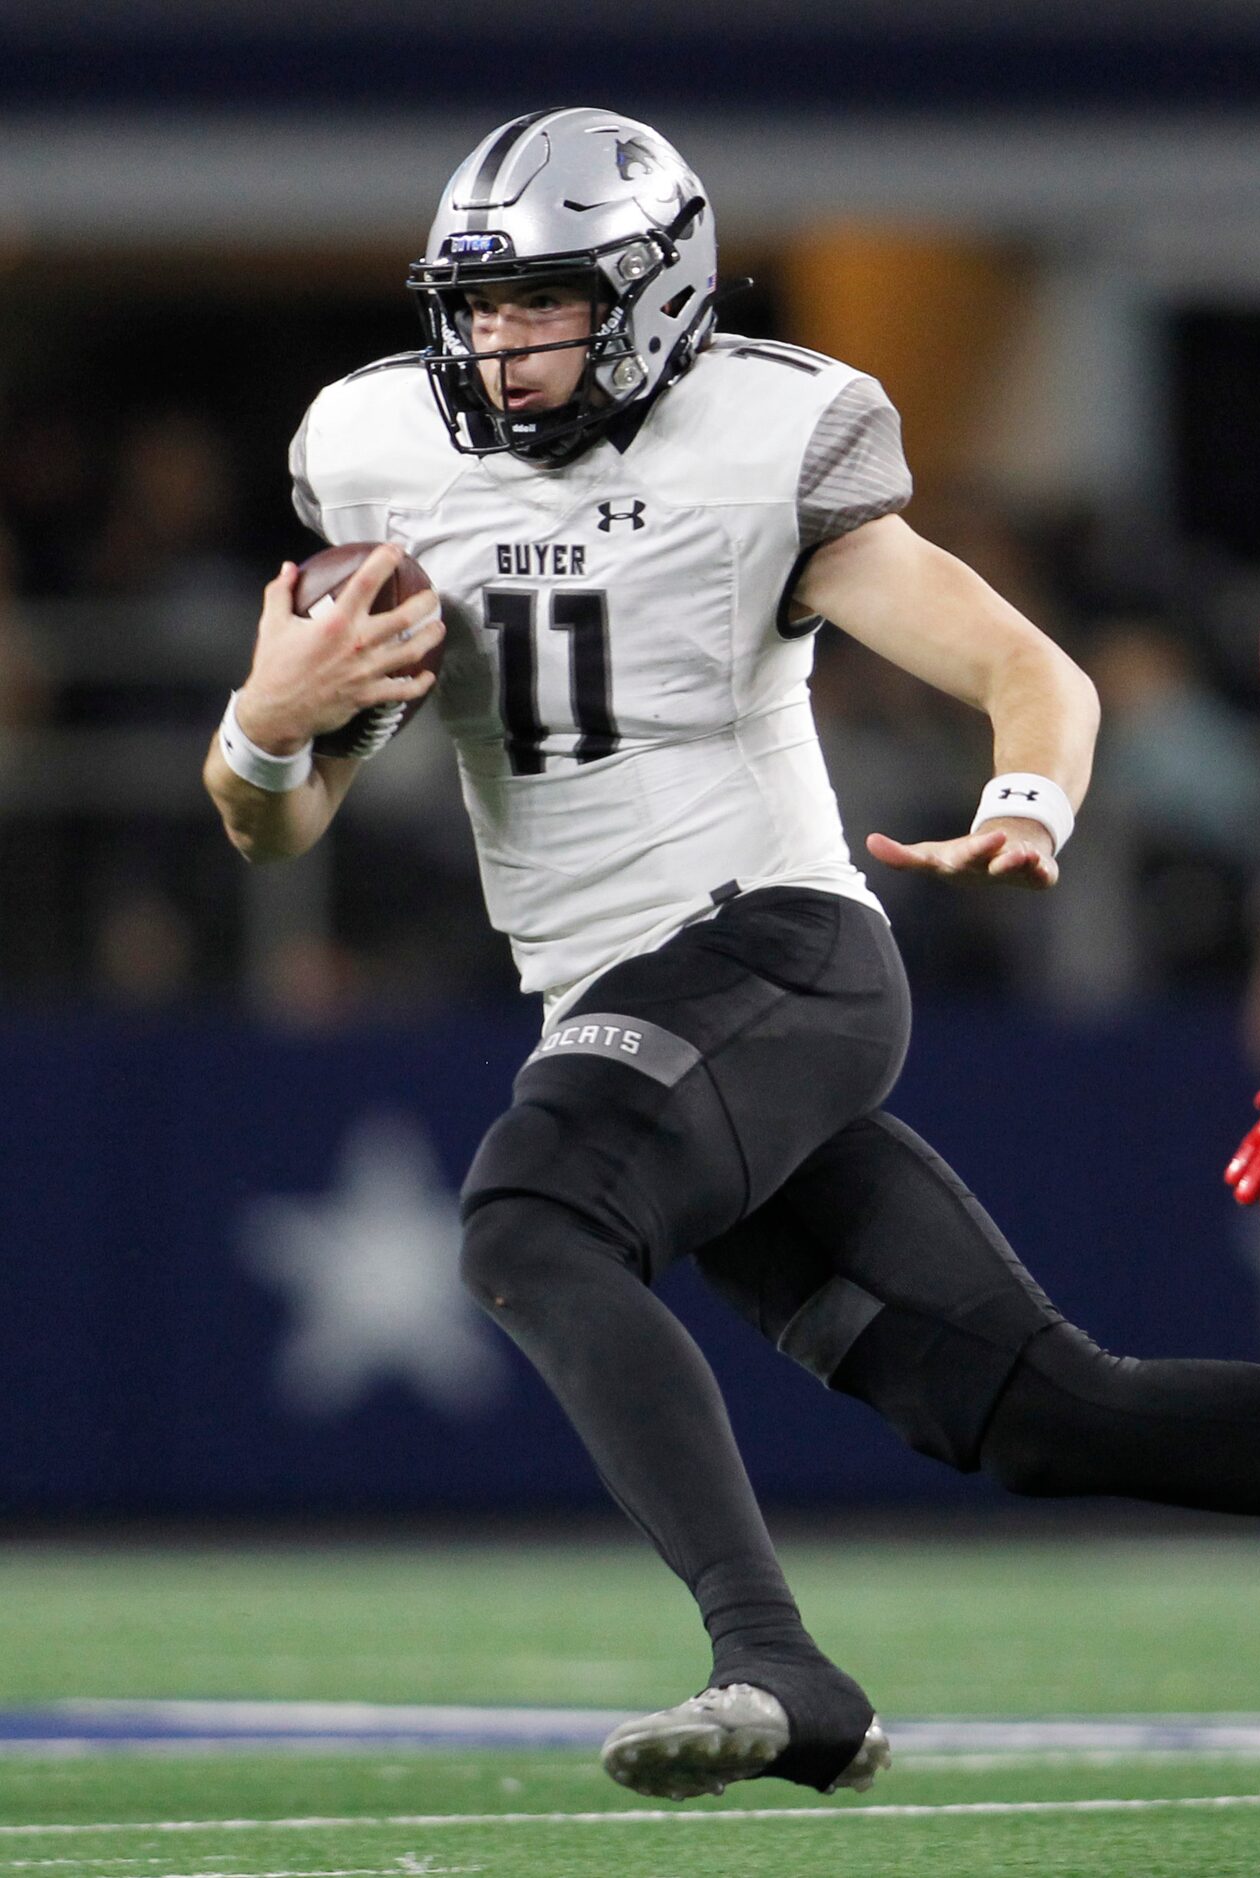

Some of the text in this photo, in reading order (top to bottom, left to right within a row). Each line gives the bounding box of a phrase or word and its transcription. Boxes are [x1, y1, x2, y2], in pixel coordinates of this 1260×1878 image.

[496, 543, 586, 576] GUYER
[482, 586, 620, 777] 11
[532, 1025, 643, 1056] DCATS
